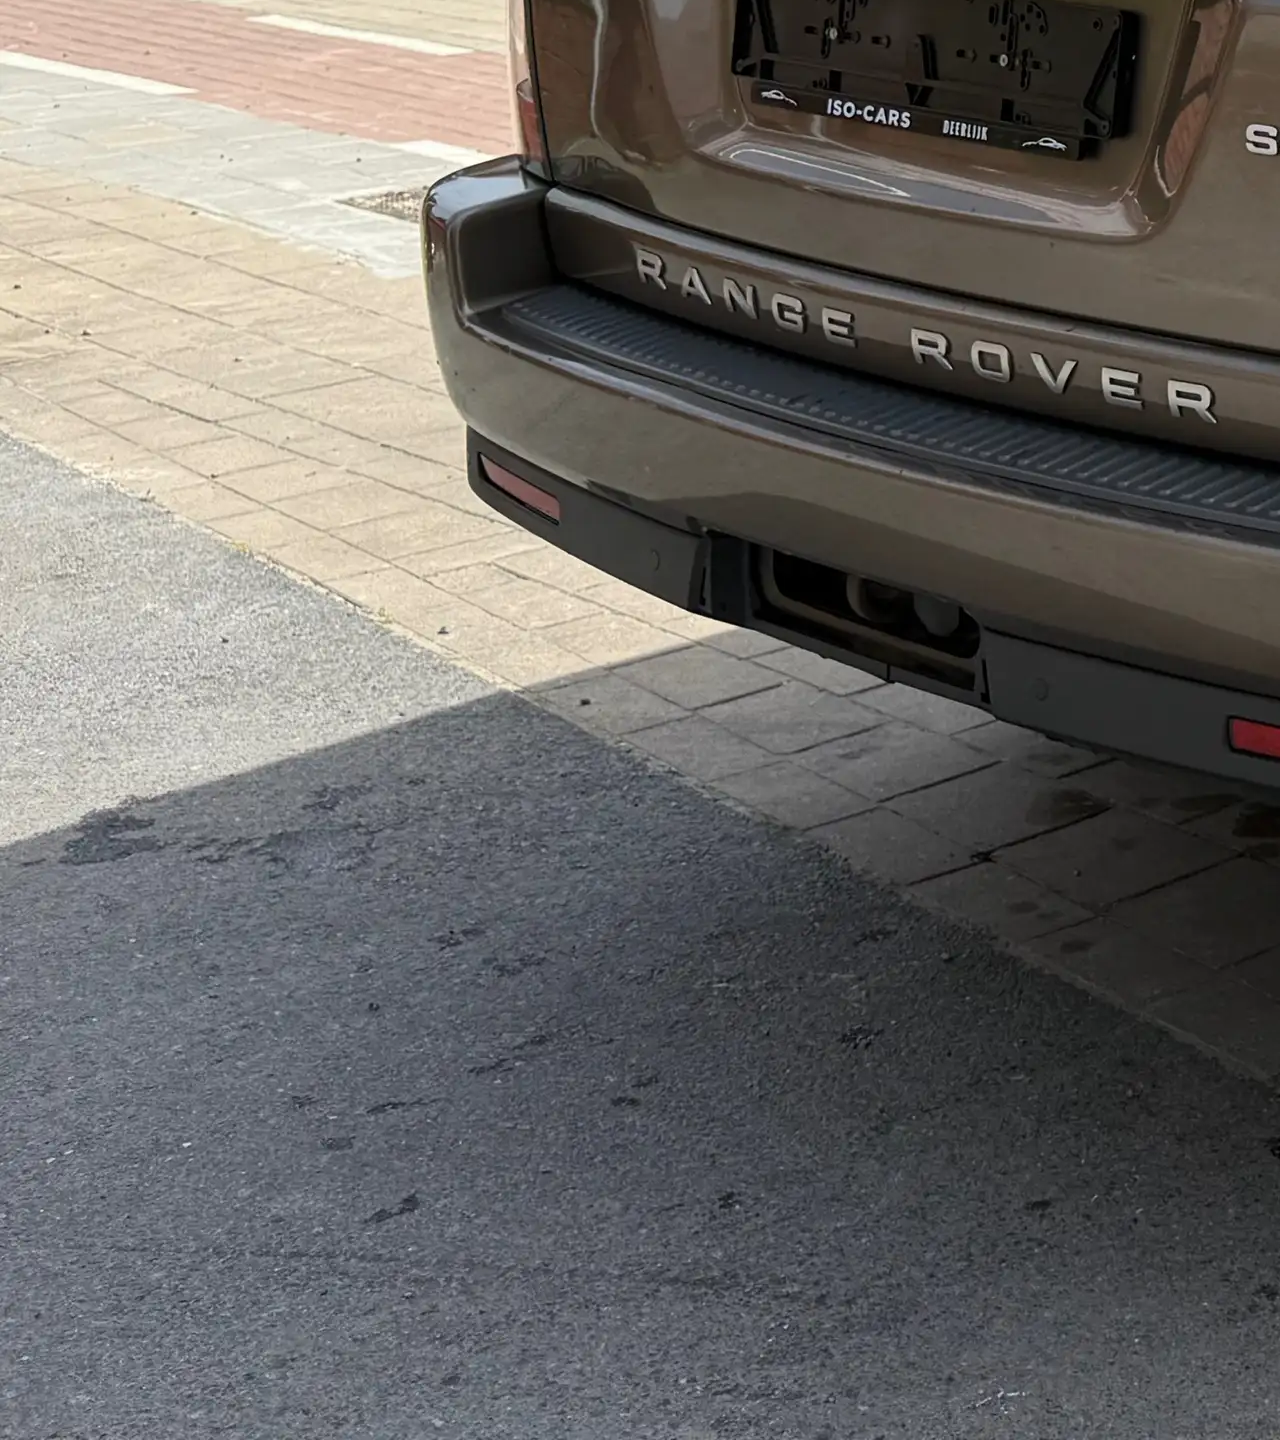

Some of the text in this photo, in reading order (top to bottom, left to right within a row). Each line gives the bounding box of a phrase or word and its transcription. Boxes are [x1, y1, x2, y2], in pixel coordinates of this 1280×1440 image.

[827, 97, 989, 142] ISO-CARS DEERLIJK
[635, 248, 1219, 424] RANGE ROVER
